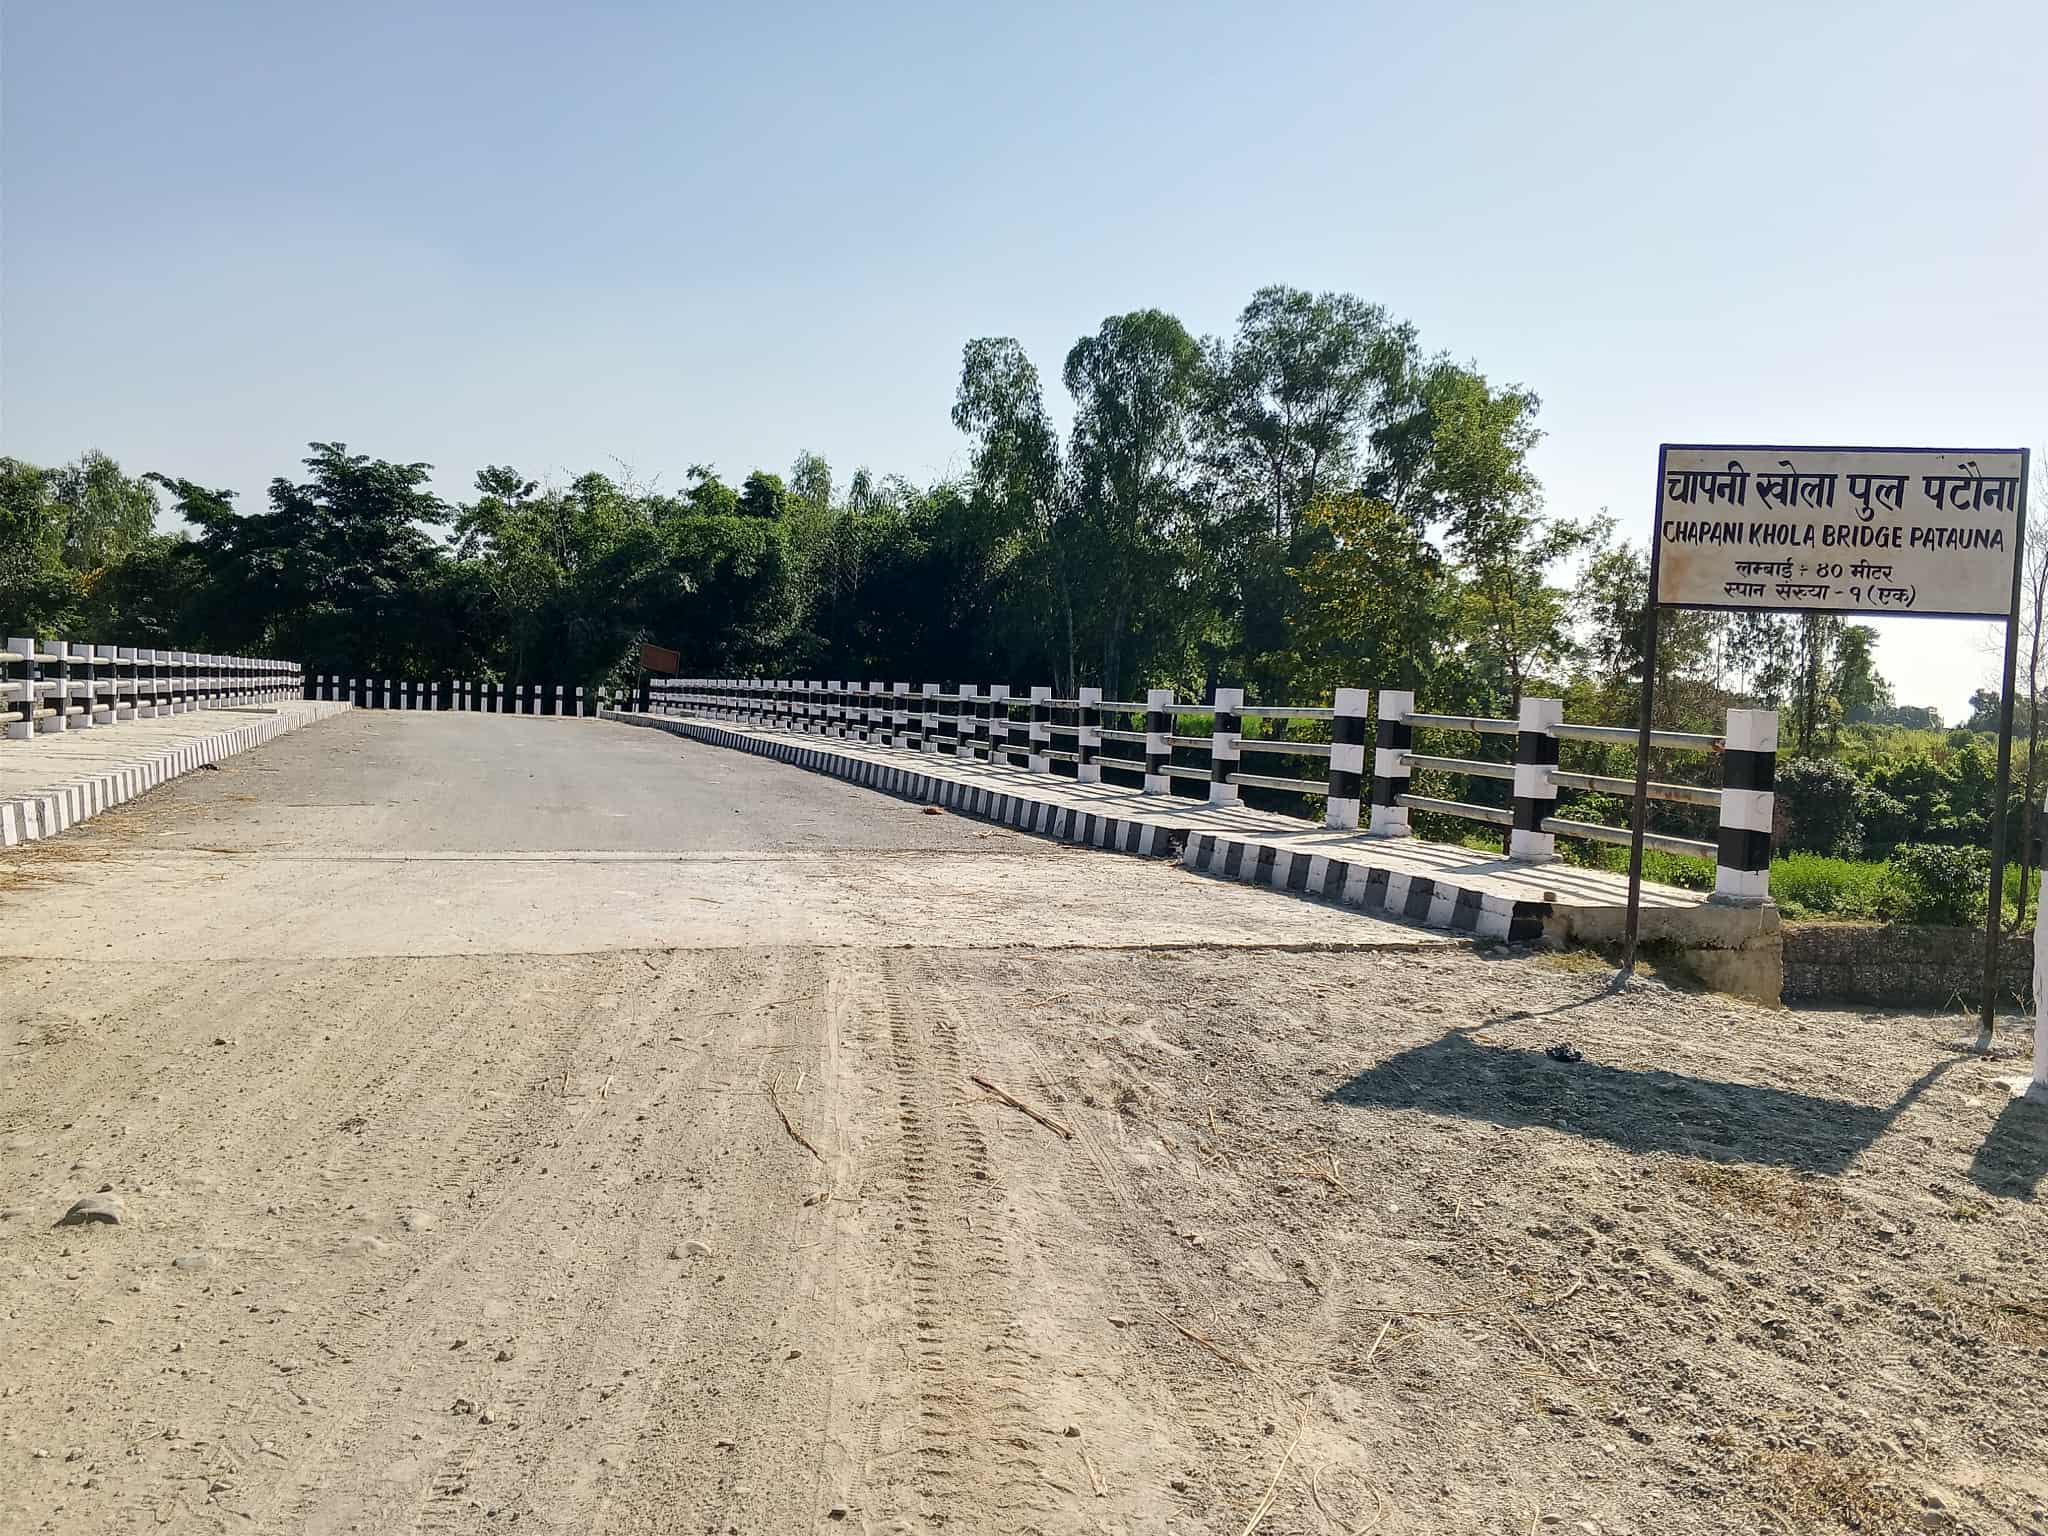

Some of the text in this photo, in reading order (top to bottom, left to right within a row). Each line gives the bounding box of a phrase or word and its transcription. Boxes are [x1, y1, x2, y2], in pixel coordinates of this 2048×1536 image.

[1666, 460, 2019, 521] चापनी खोला पुल पटौना
[1663, 520, 2003, 552] CHAPANI KHOLA BRIDGE PATAUNA
[1735, 557, 1794, 579] लम्बाई
[1816, 563, 1843, 578] ४०
[1850, 559, 1894, 582] मीटर
[1724, 582, 1767, 599] स्पान
[1868, 585, 1916, 607] (एक)
